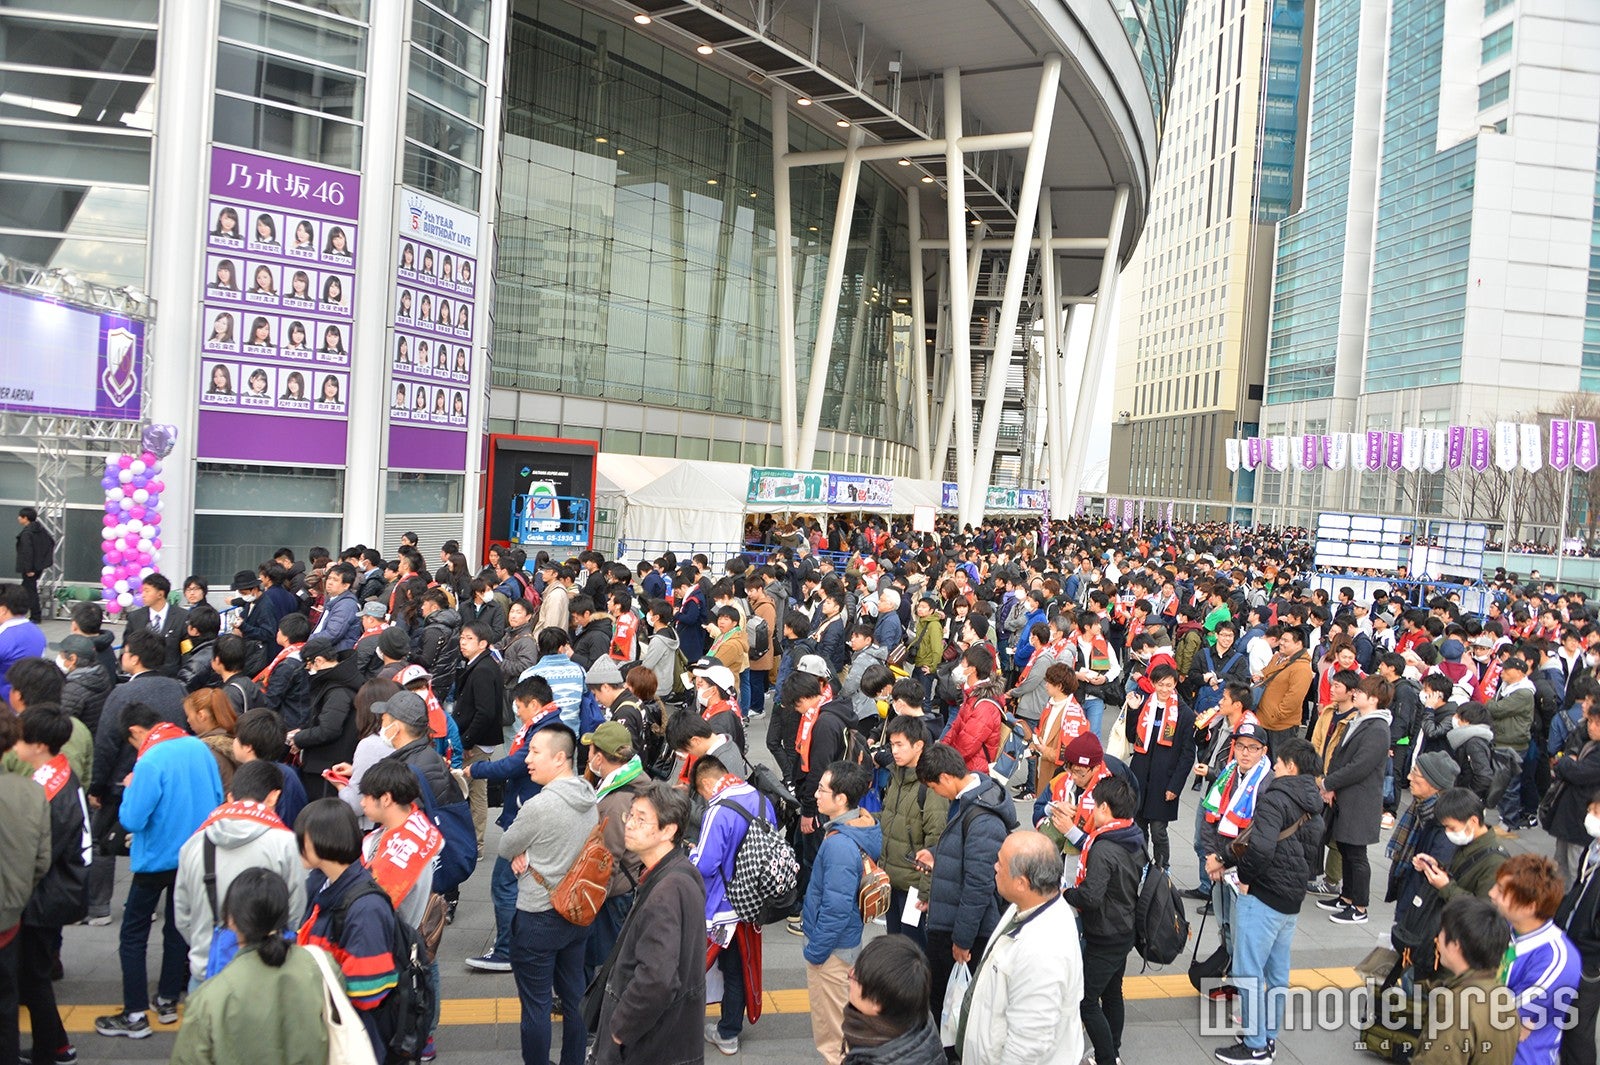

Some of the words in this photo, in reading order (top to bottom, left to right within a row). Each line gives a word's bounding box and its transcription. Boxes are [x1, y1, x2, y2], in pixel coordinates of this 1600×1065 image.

[226, 163, 344, 206] 乃木坂46
[424, 211, 435, 223] 5th
[436, 214, 454, 230] YEAR
[423, 222, 456, 243] BIRTHDAY
[457, 234, 471, 247] LIVE
[11, 388, 34, 401] ARENA
[381, 811, 430, 870] 高山
